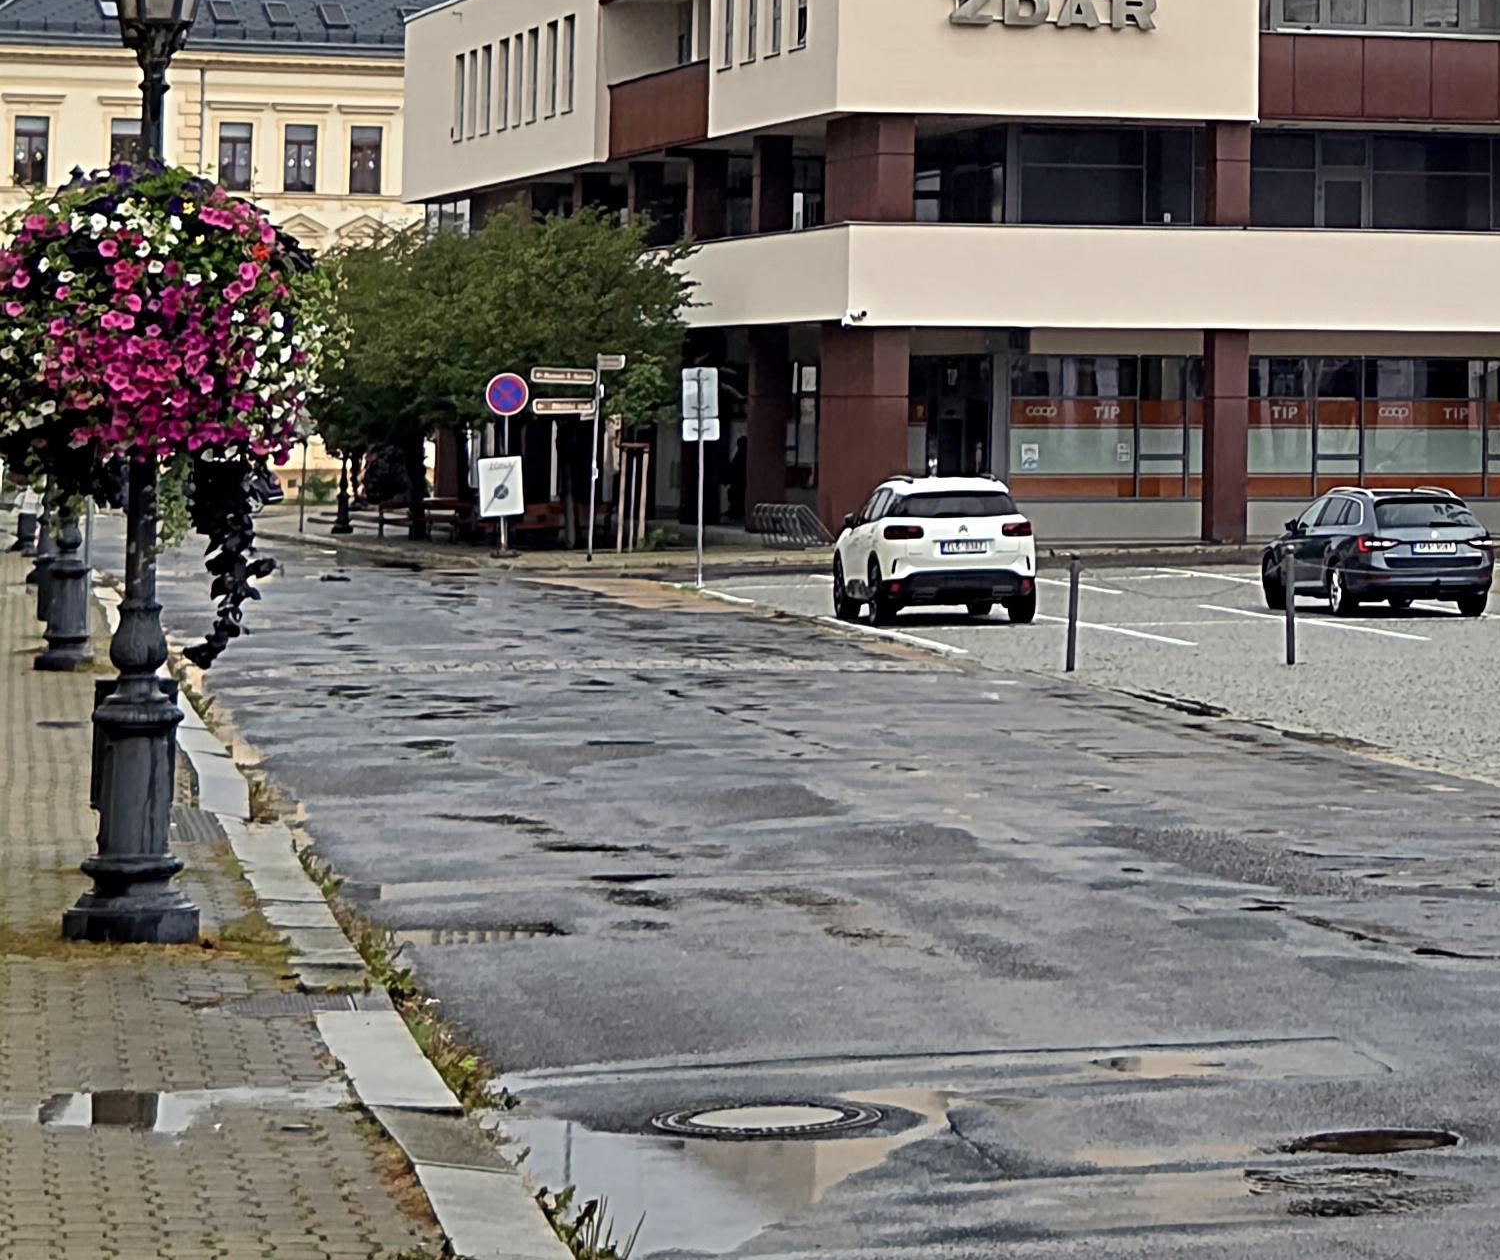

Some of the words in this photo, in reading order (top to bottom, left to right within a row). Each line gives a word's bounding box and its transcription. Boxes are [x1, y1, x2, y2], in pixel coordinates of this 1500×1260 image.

[1093, 405, 1121, 420] TIP
[1271, 406, 1299, 420] TIP
[1442, 407, 1470, 420] TIP
